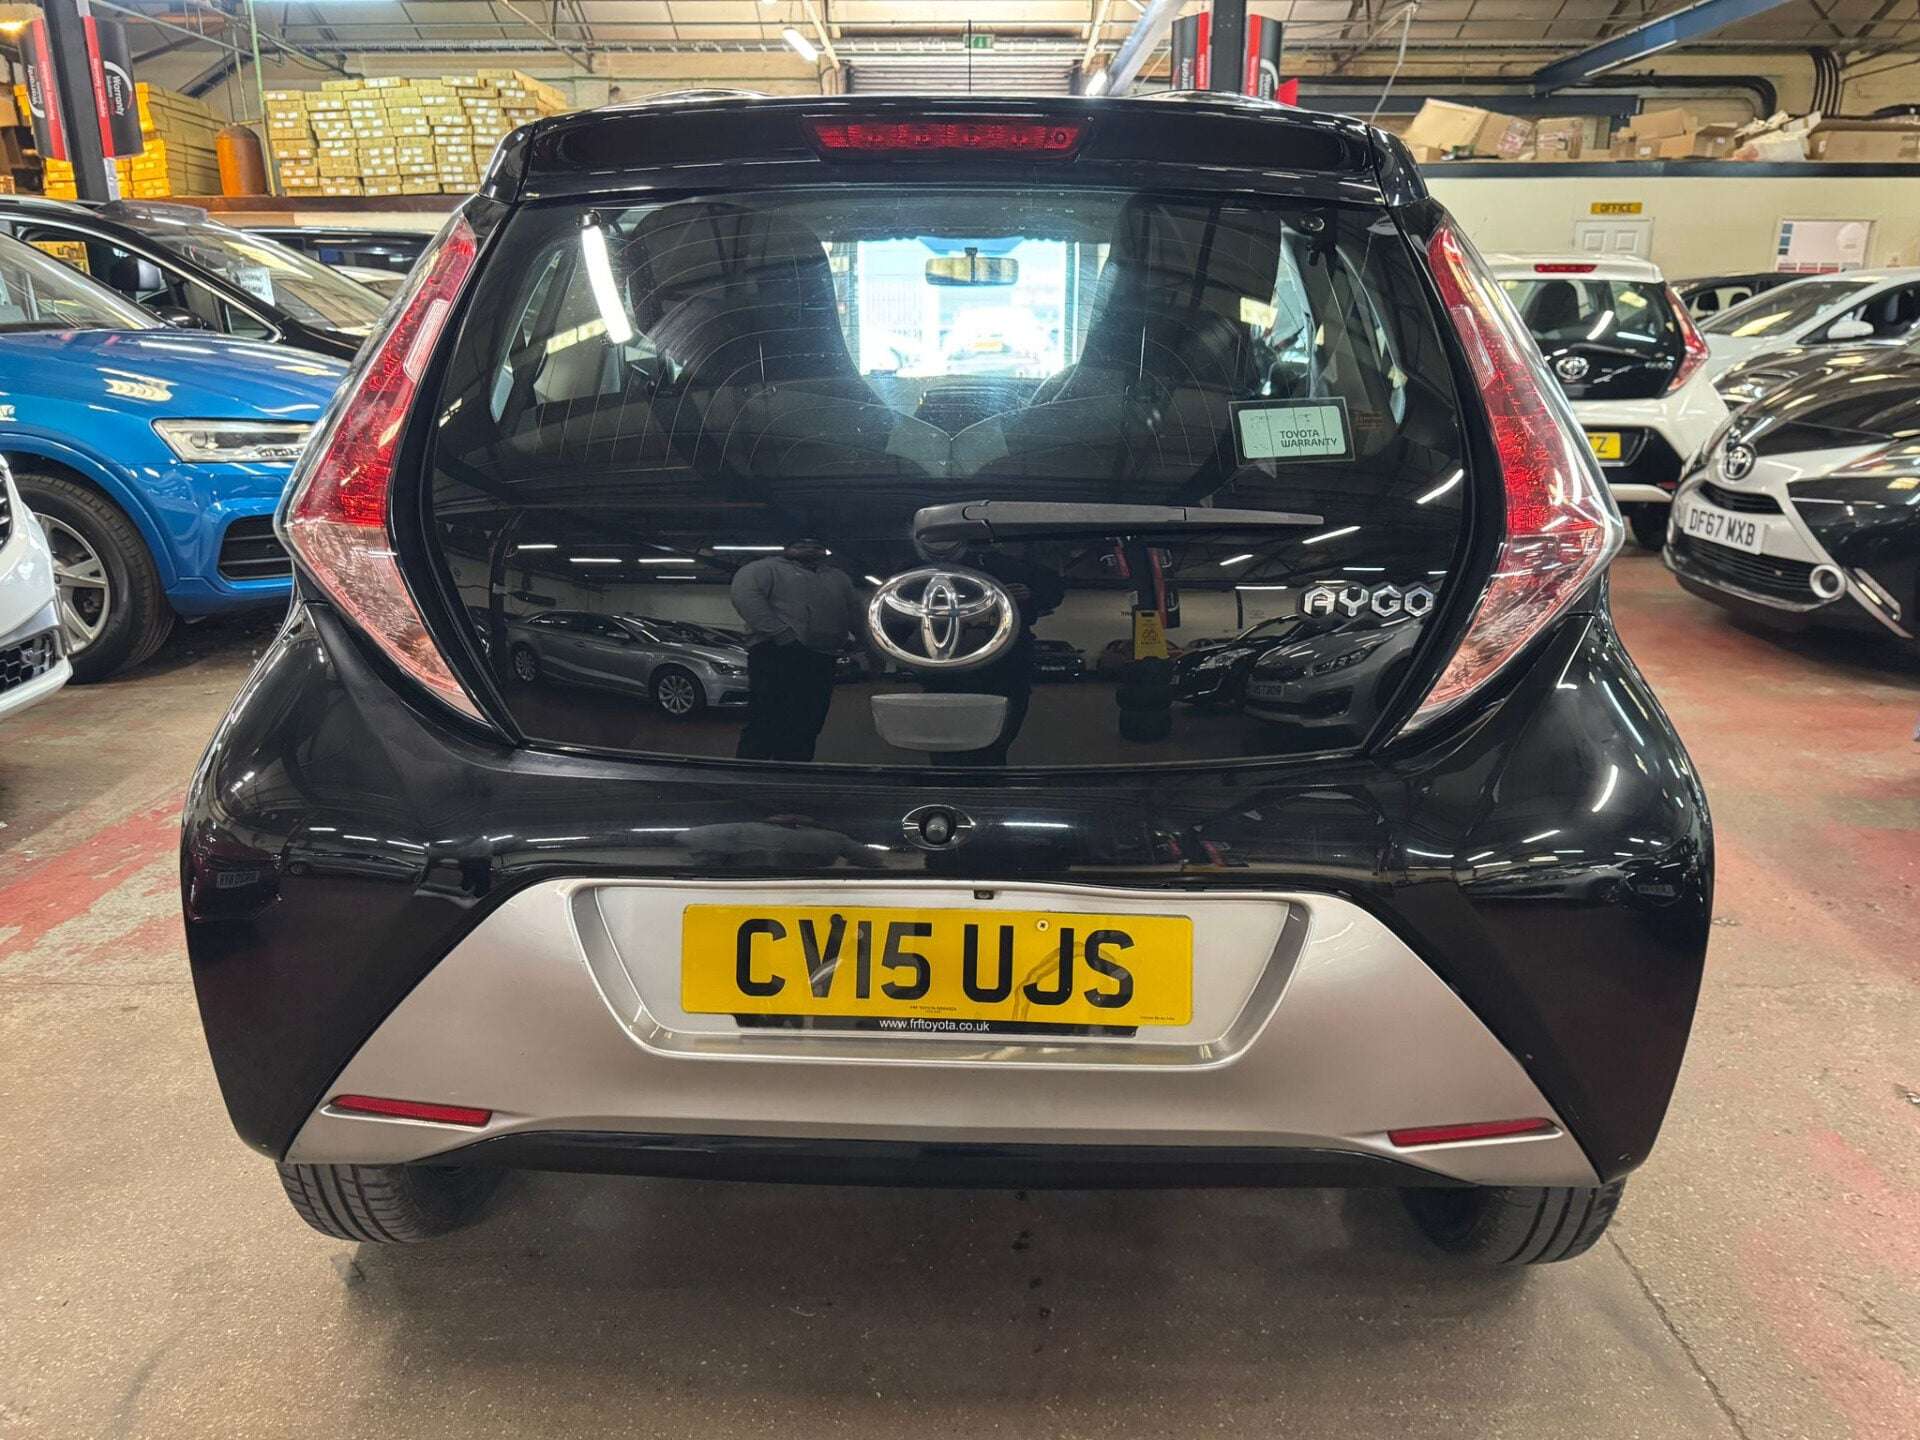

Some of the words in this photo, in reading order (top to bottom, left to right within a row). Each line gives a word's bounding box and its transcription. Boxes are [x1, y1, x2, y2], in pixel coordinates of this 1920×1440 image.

[112, 75, 125, 116] Warranty
[1600, 203, 1632, 213] OFFICE
[1280, 429, 1320, 439] TOYOTA
[1280, 437, 1337, 448] WARRANTY
[1689, 508, 1724, 538] DF67
[1726, 517, 1756, 546] MXB
[1303, 584, 1434, 617] AYGO
[736, 914, 932, 1000] CV15
[962, 924, 1134, 1008] UJS
[879, 1018, 990, 1032] www.frftoyota.co.uk
